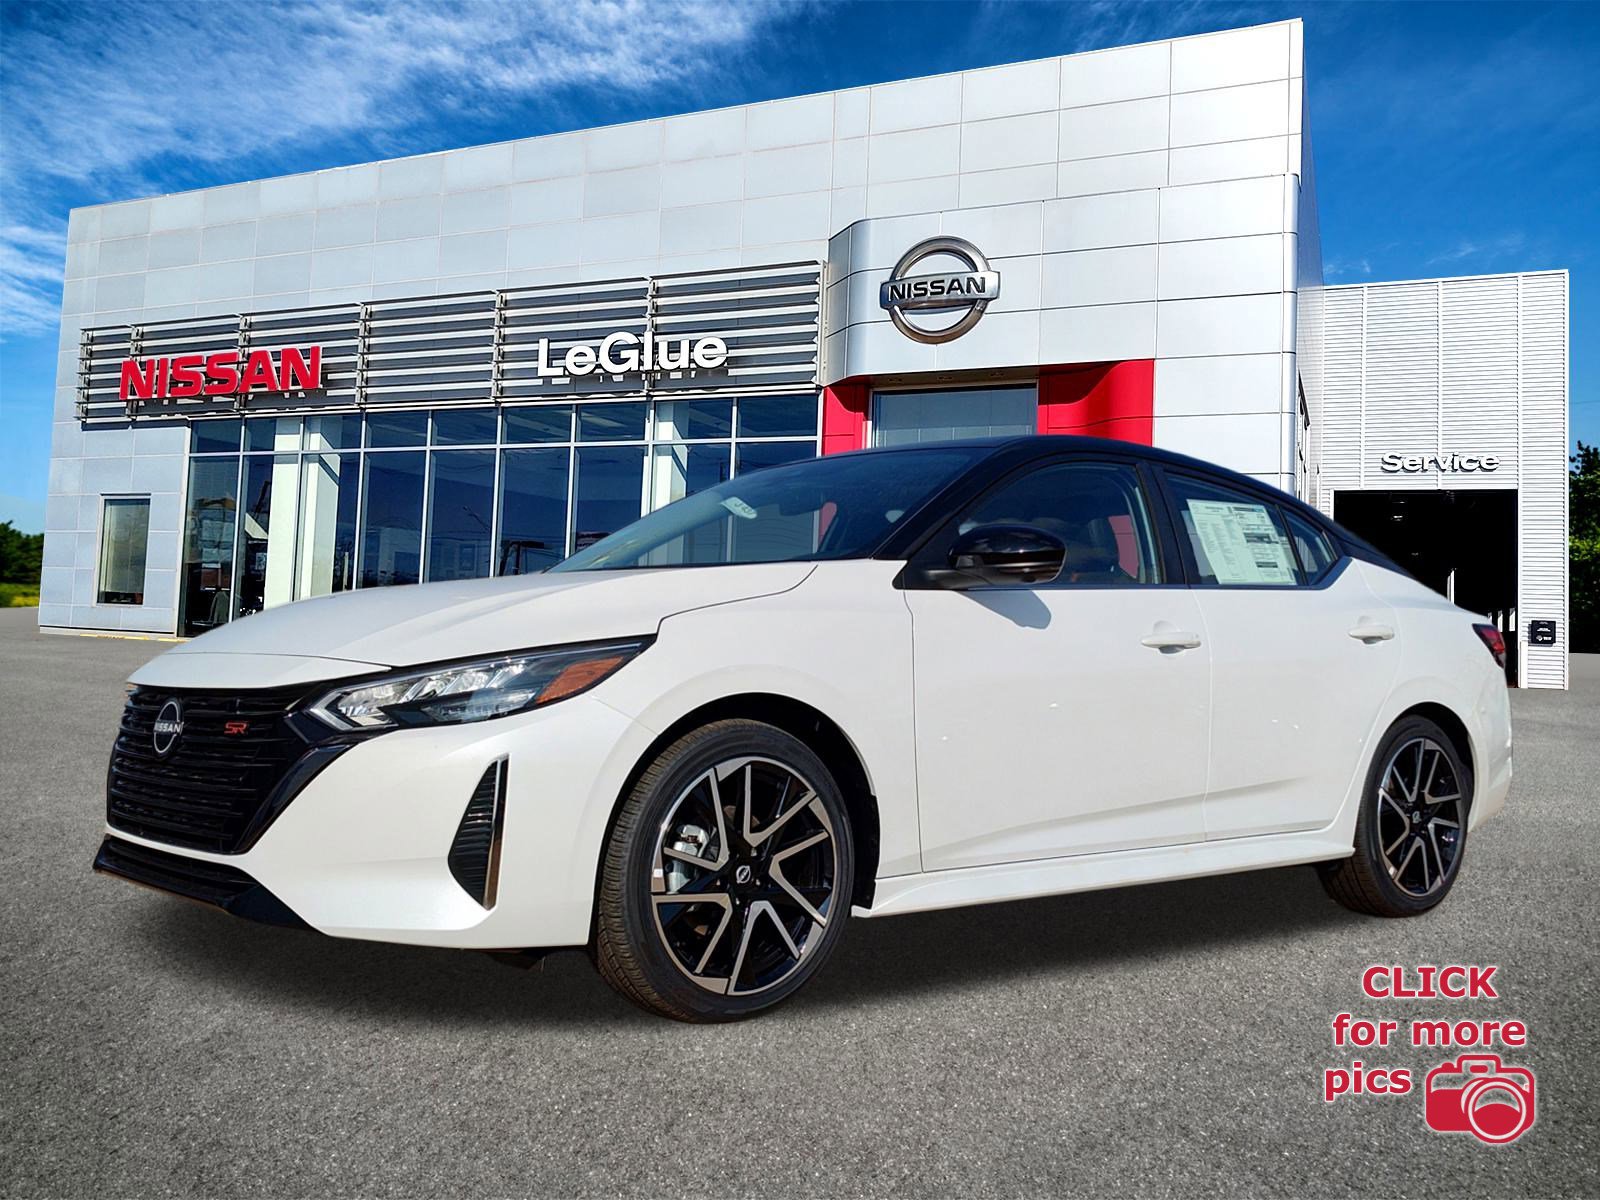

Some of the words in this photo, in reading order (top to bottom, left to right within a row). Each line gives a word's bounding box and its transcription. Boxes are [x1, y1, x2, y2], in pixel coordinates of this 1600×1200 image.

[887, 276, 987, 301] NISSAN
[537, 331, 729, 377] LeGlue
[119, 345, 323, 401] NISSAN
[1380, 451, 1500, 474] Service
[154, 720, 183, 733] NISSAN
[223, 720, 249, 735] SR
